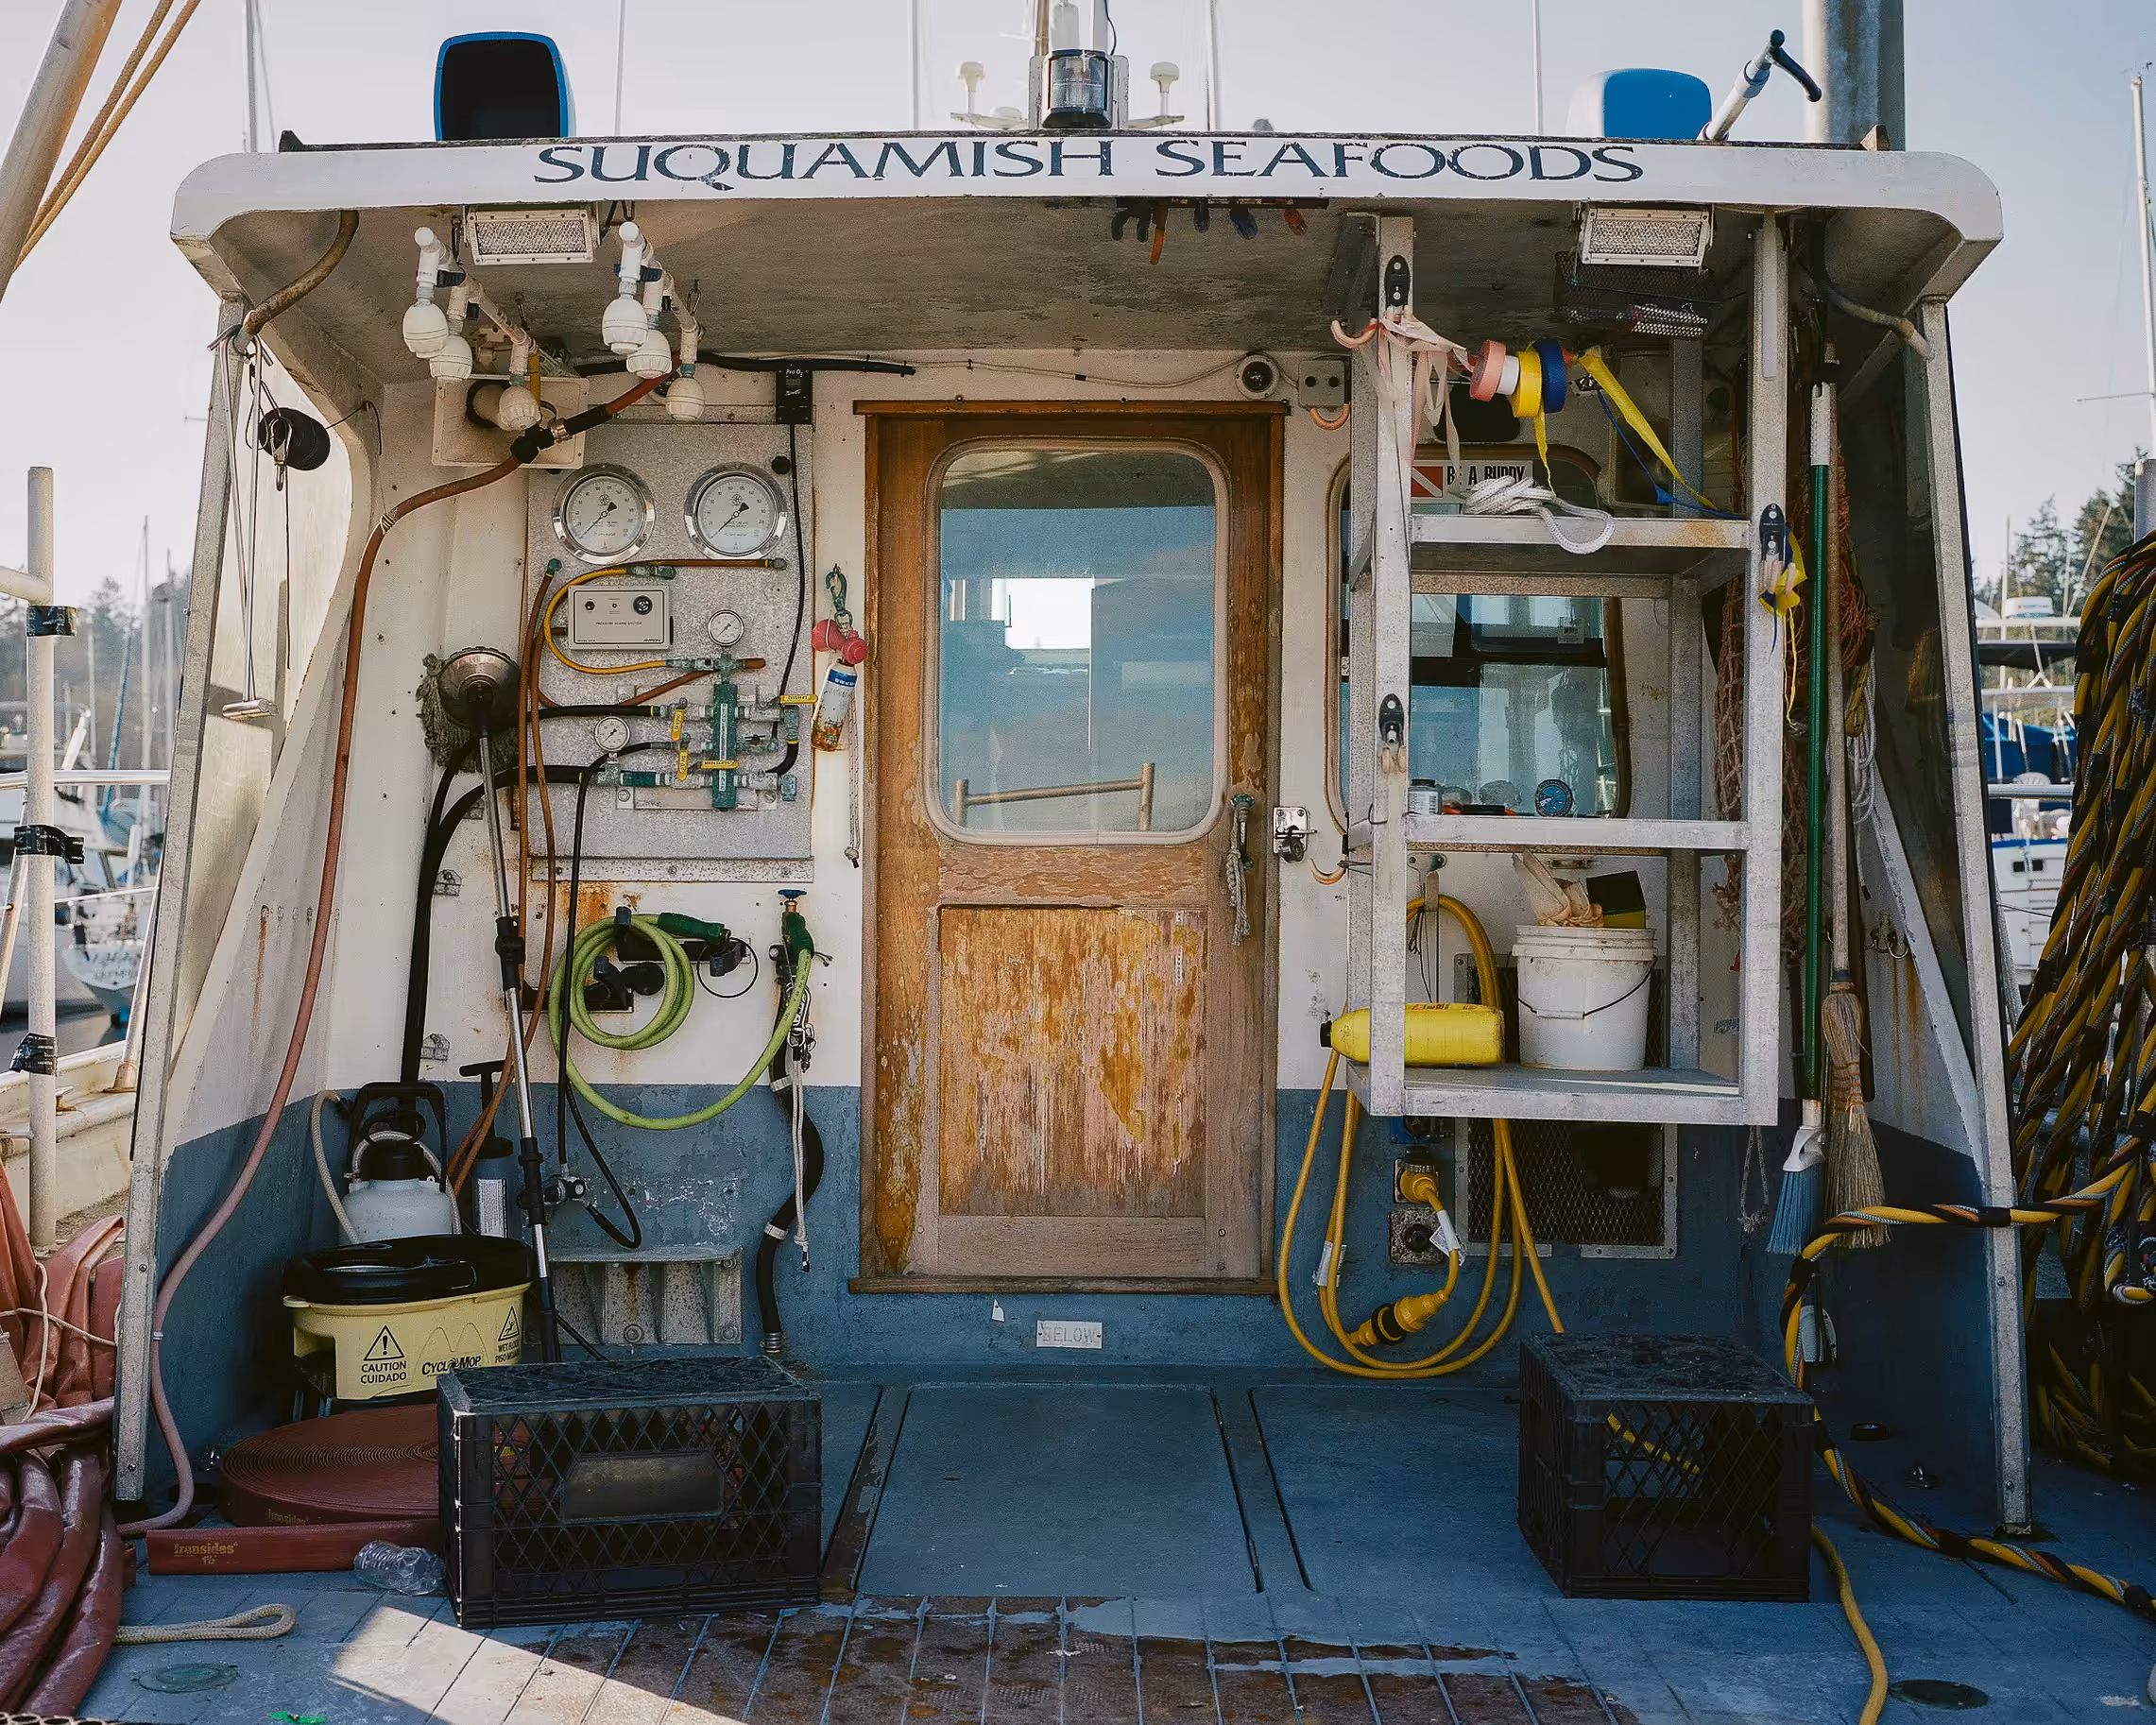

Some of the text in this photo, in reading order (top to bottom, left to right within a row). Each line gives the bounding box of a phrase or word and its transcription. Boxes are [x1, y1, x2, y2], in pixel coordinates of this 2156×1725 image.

[533, 138, 1644, 191] SUQUAMISH SEAFOODS
[1446, 465, 1463, 486] B
[1467, 465, 1478, 486] A
[361, 1360, 407, 1374] CAUTION
[360, 1371, 407, 1384] CUIDADO
